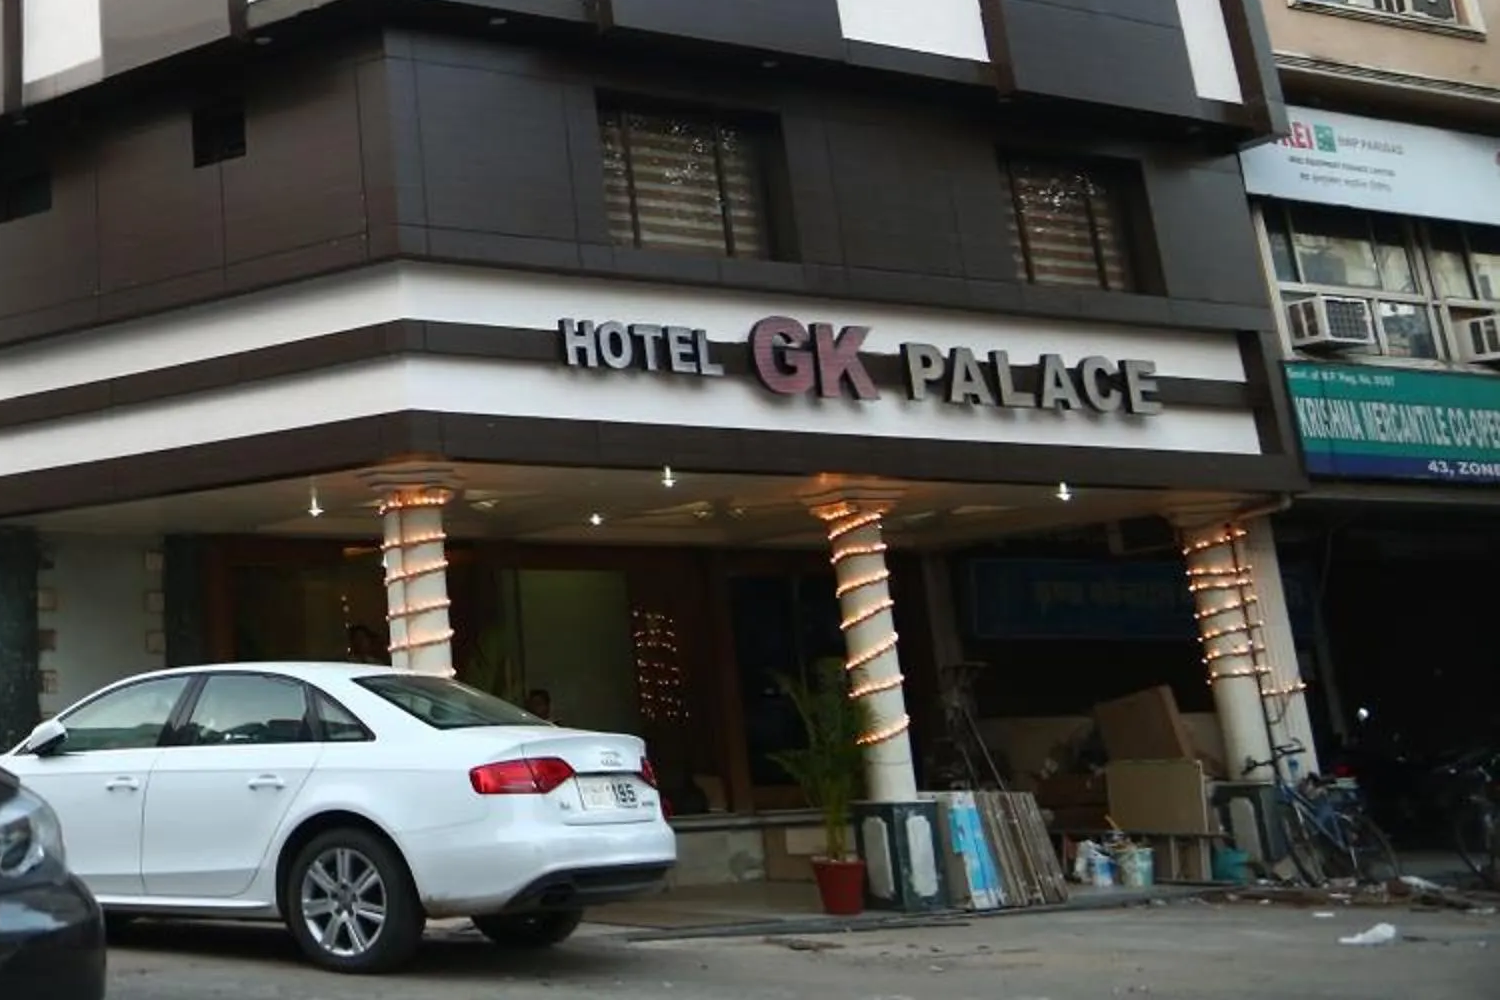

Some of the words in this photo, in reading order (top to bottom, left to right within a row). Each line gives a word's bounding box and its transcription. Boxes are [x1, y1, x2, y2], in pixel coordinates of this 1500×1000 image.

[558, 317, 724, 377] HOTEL
[747, 315, 882, 400] GK
[899, 341, 1164, 416] PALACE
